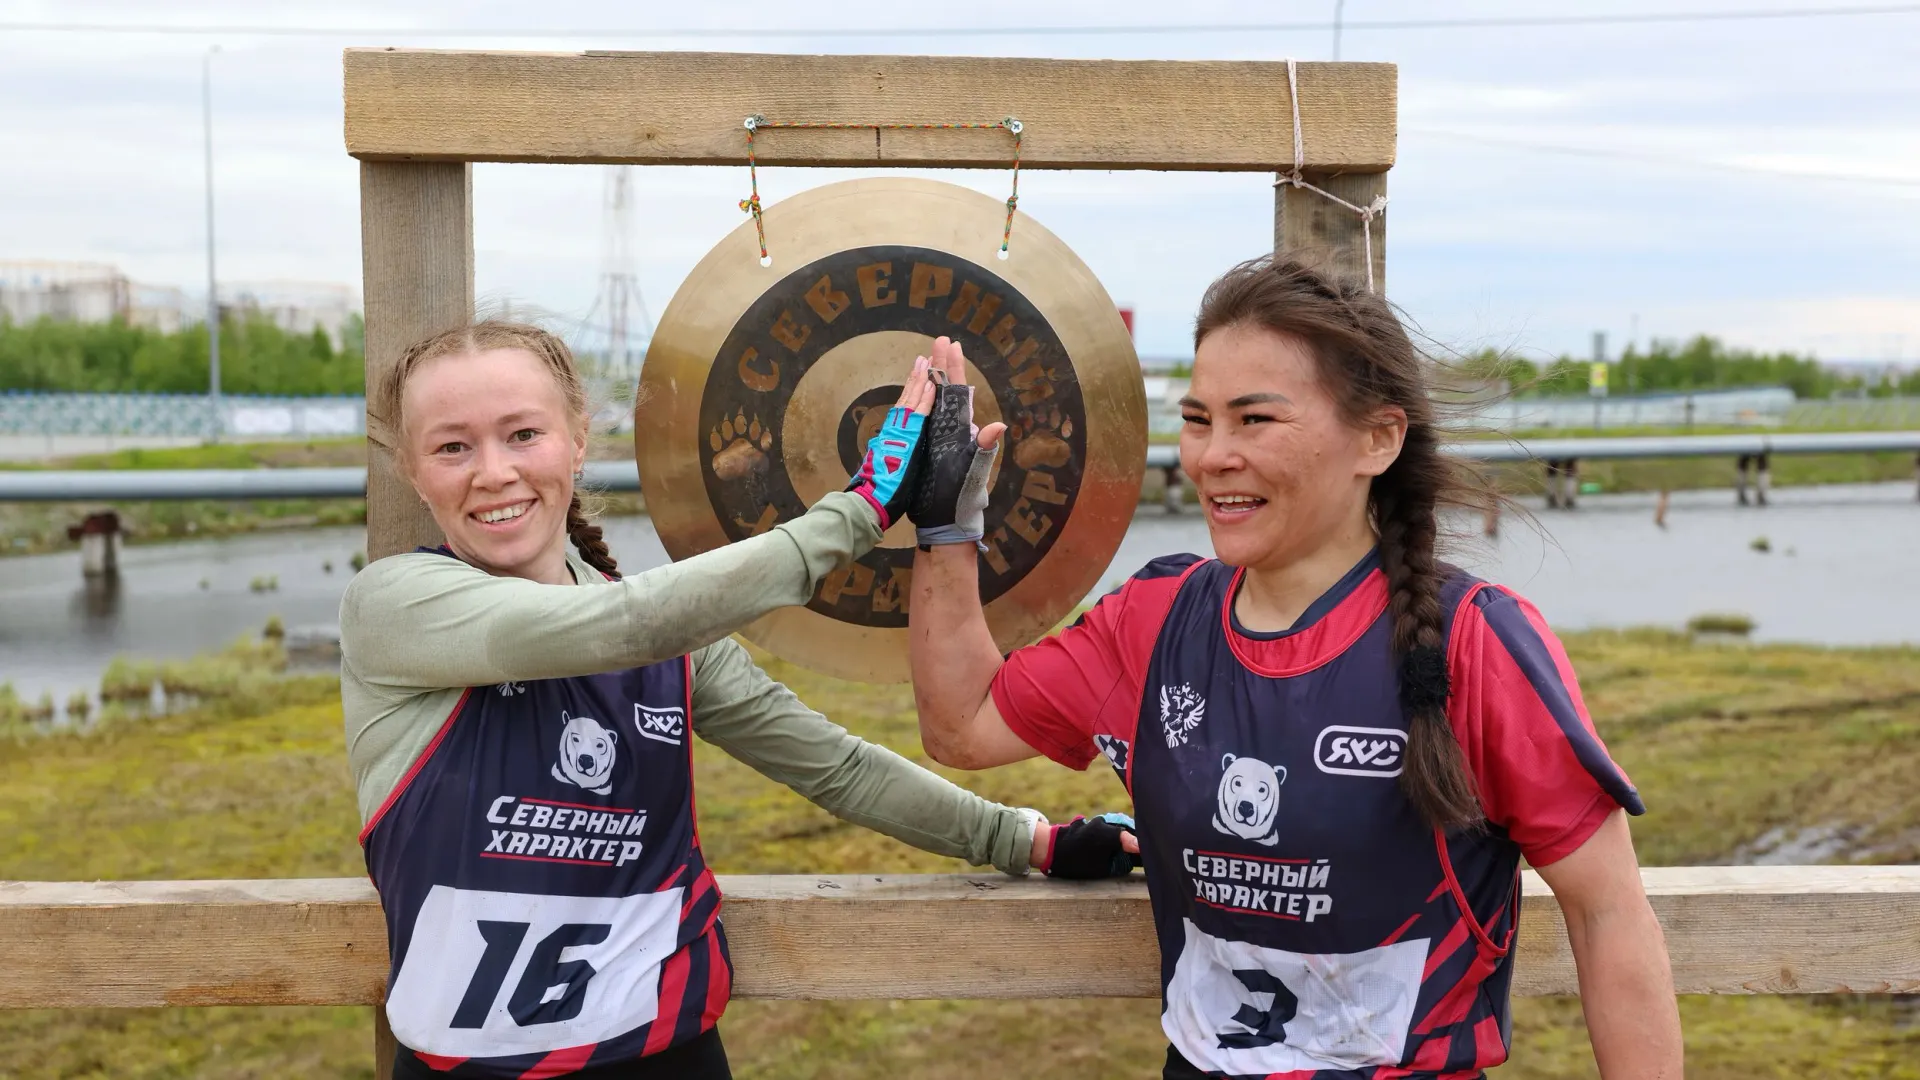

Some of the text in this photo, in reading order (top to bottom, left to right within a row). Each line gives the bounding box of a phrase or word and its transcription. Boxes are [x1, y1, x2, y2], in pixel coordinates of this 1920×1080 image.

[739, 262, 1055, 405] СЕВЕРНЫЙ
[486, 796, 647, 836] СЕВЕРНЫЙ
[484, 830, 643, 867] ХАРАКТЕР
[1183, 848, 1331, 888] СЕВЕРНЫЙ
[1192, 878, 1332, 922] ХАРАКТЕР
[449, 920, 612, 1029] 16
